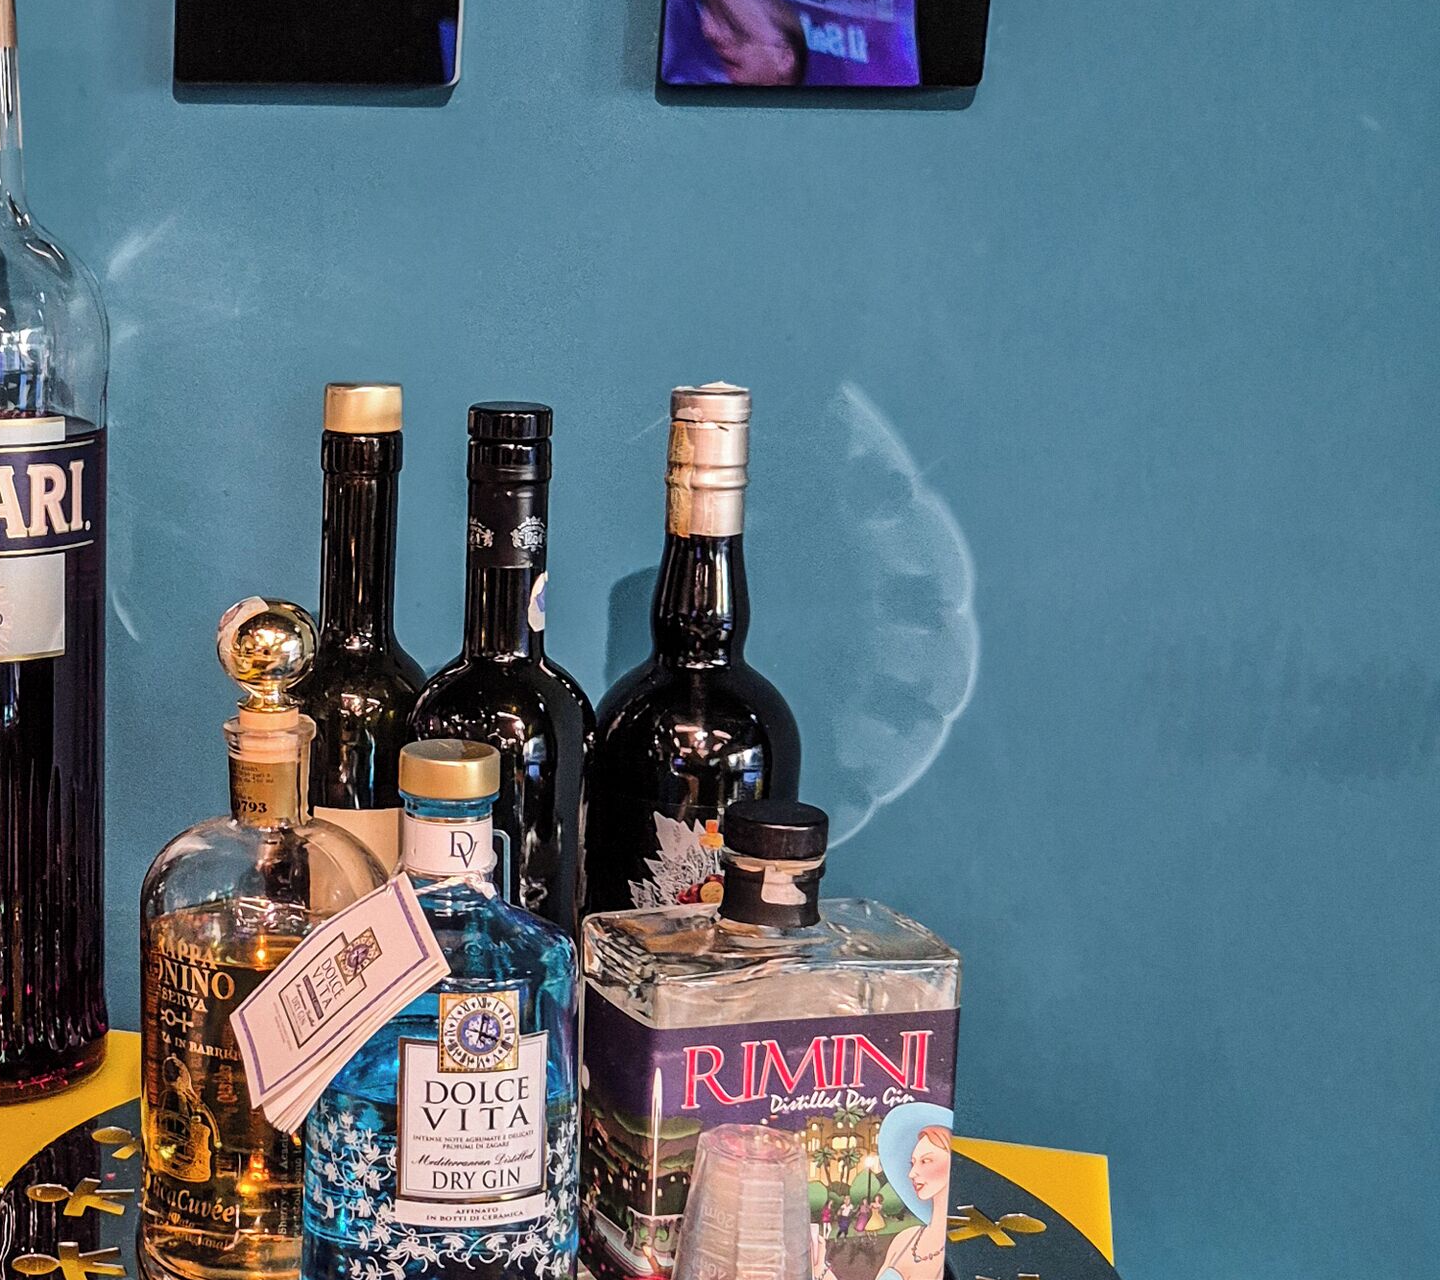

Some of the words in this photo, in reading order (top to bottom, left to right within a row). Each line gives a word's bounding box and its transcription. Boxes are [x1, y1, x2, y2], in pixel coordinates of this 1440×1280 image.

[312, 966, 333, 1010] VITA
[321, 957, 345, 1001] DOLCE
[681, 1030, 934, 1110] RIMINI
[424, 1075, 529, 1105] DOLCE
[770, 1090, 841, 1114] Distilled
[846, 1089, 878, 1113] Dry
[882, 1086, 915, 1107] Gin
[421, 1103, 530, 1131] VITA
[432, 1170, 477, 1190] DRY
[482, 1166, 521, 1190] GIN
[439, 1214, 467, 1222] BOTTI
[469, 1214, 480, 1222] DI
[482, 1210, 524, 1221] CERAMICA
[455, 1207, 498, 1215] AFFINATO
